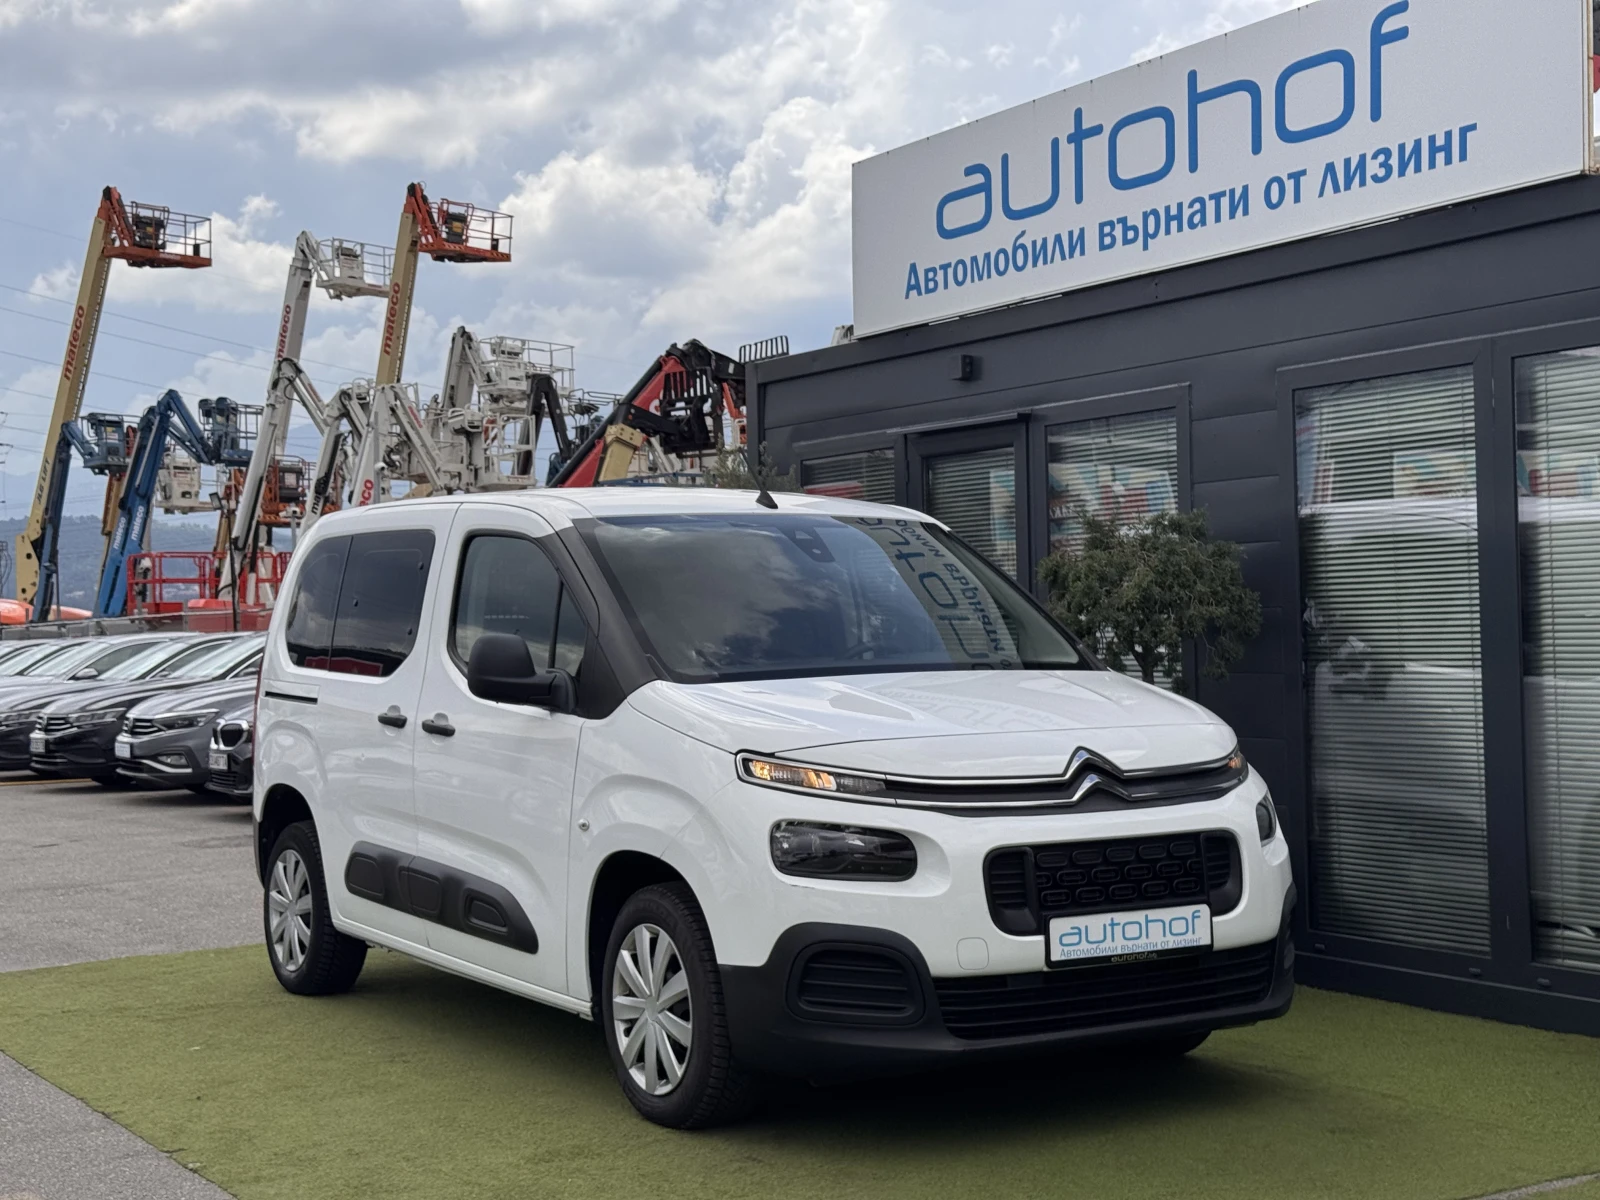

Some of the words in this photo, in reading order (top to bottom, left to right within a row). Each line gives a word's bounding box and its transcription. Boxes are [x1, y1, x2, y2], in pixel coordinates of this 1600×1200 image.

[936, 0, 1410, 240] autohof
[904, 226, 1086, 300] Автомобили
[1098, 184, 1250, 252] върнати
[1263, 168, 1308, 211] от
[1317, 122, 1478, 199] лизинг
[63, 304, 85, 381] mateco
[384, 282, 400, 356] mateco
[131, 505, 145, 541] mateco
[1058, 909, 1201, 947] autohof
[1059, 945, 1118, 958] Автомобили
[1120, 941, 1158, 953] върнати
[1160, 940, 1171, 948] от
[1172, 937, 1202, 947] лизинг
